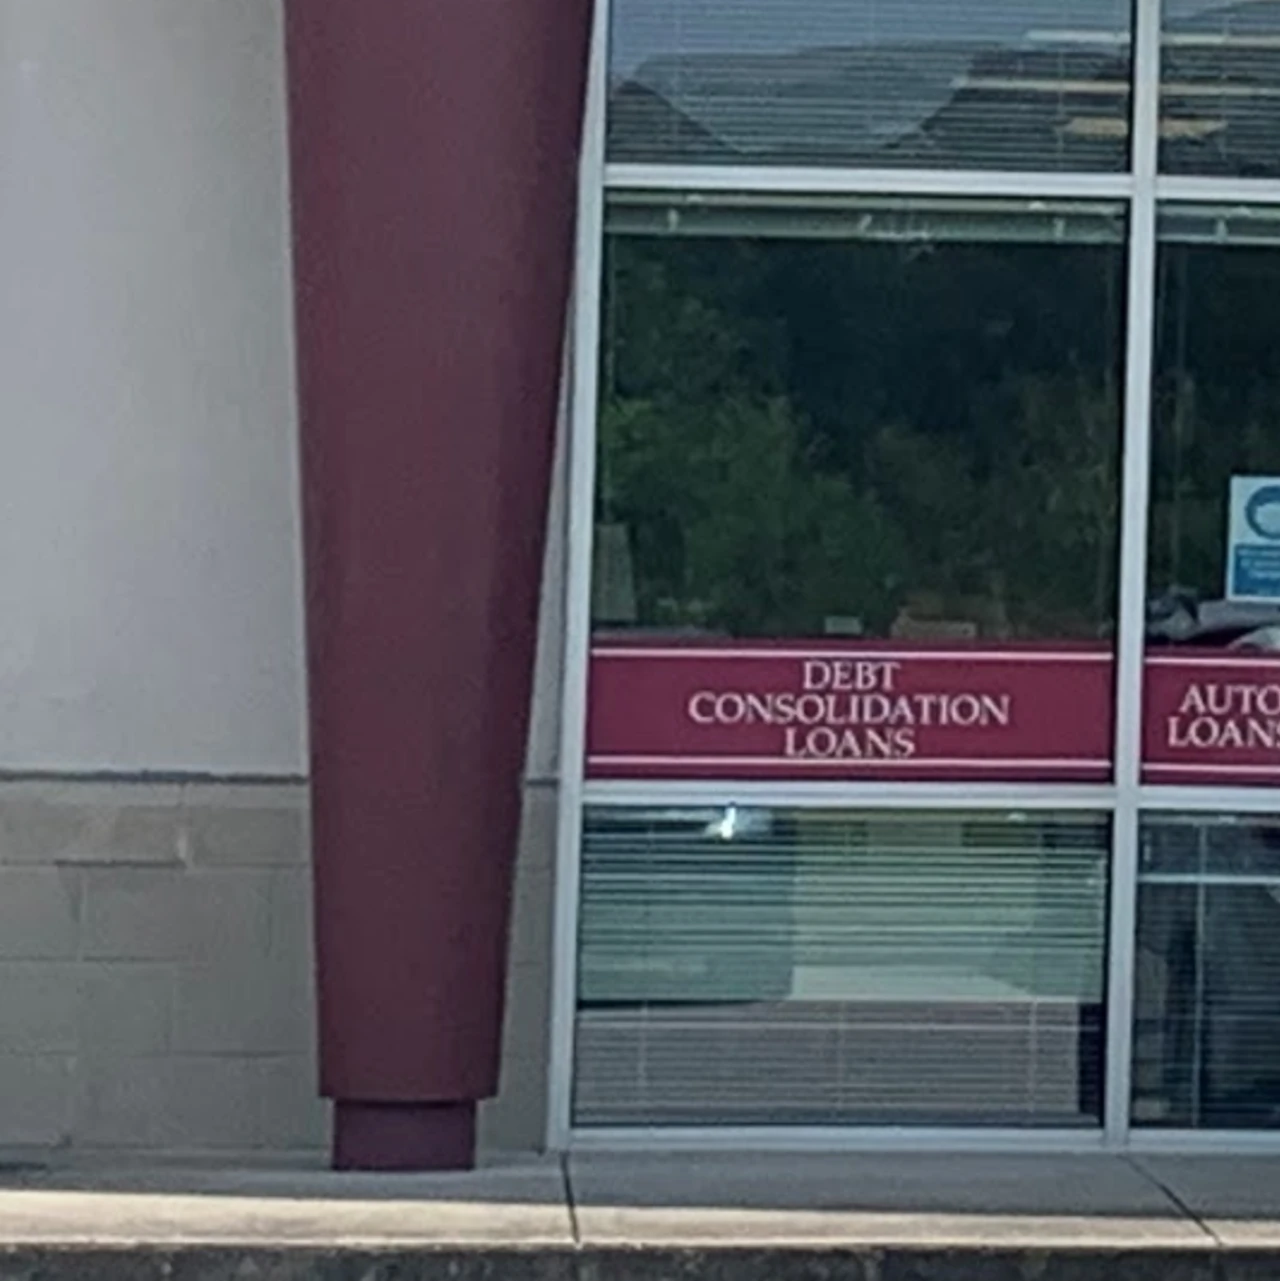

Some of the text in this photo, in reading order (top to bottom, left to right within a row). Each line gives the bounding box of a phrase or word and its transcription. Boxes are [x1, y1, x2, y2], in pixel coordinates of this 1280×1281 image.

[803, 660, 900, 691] DEBT
[688, 691, 1012, 726] CONSOLIDATION
[785, 727, 916, 759] LOANS
